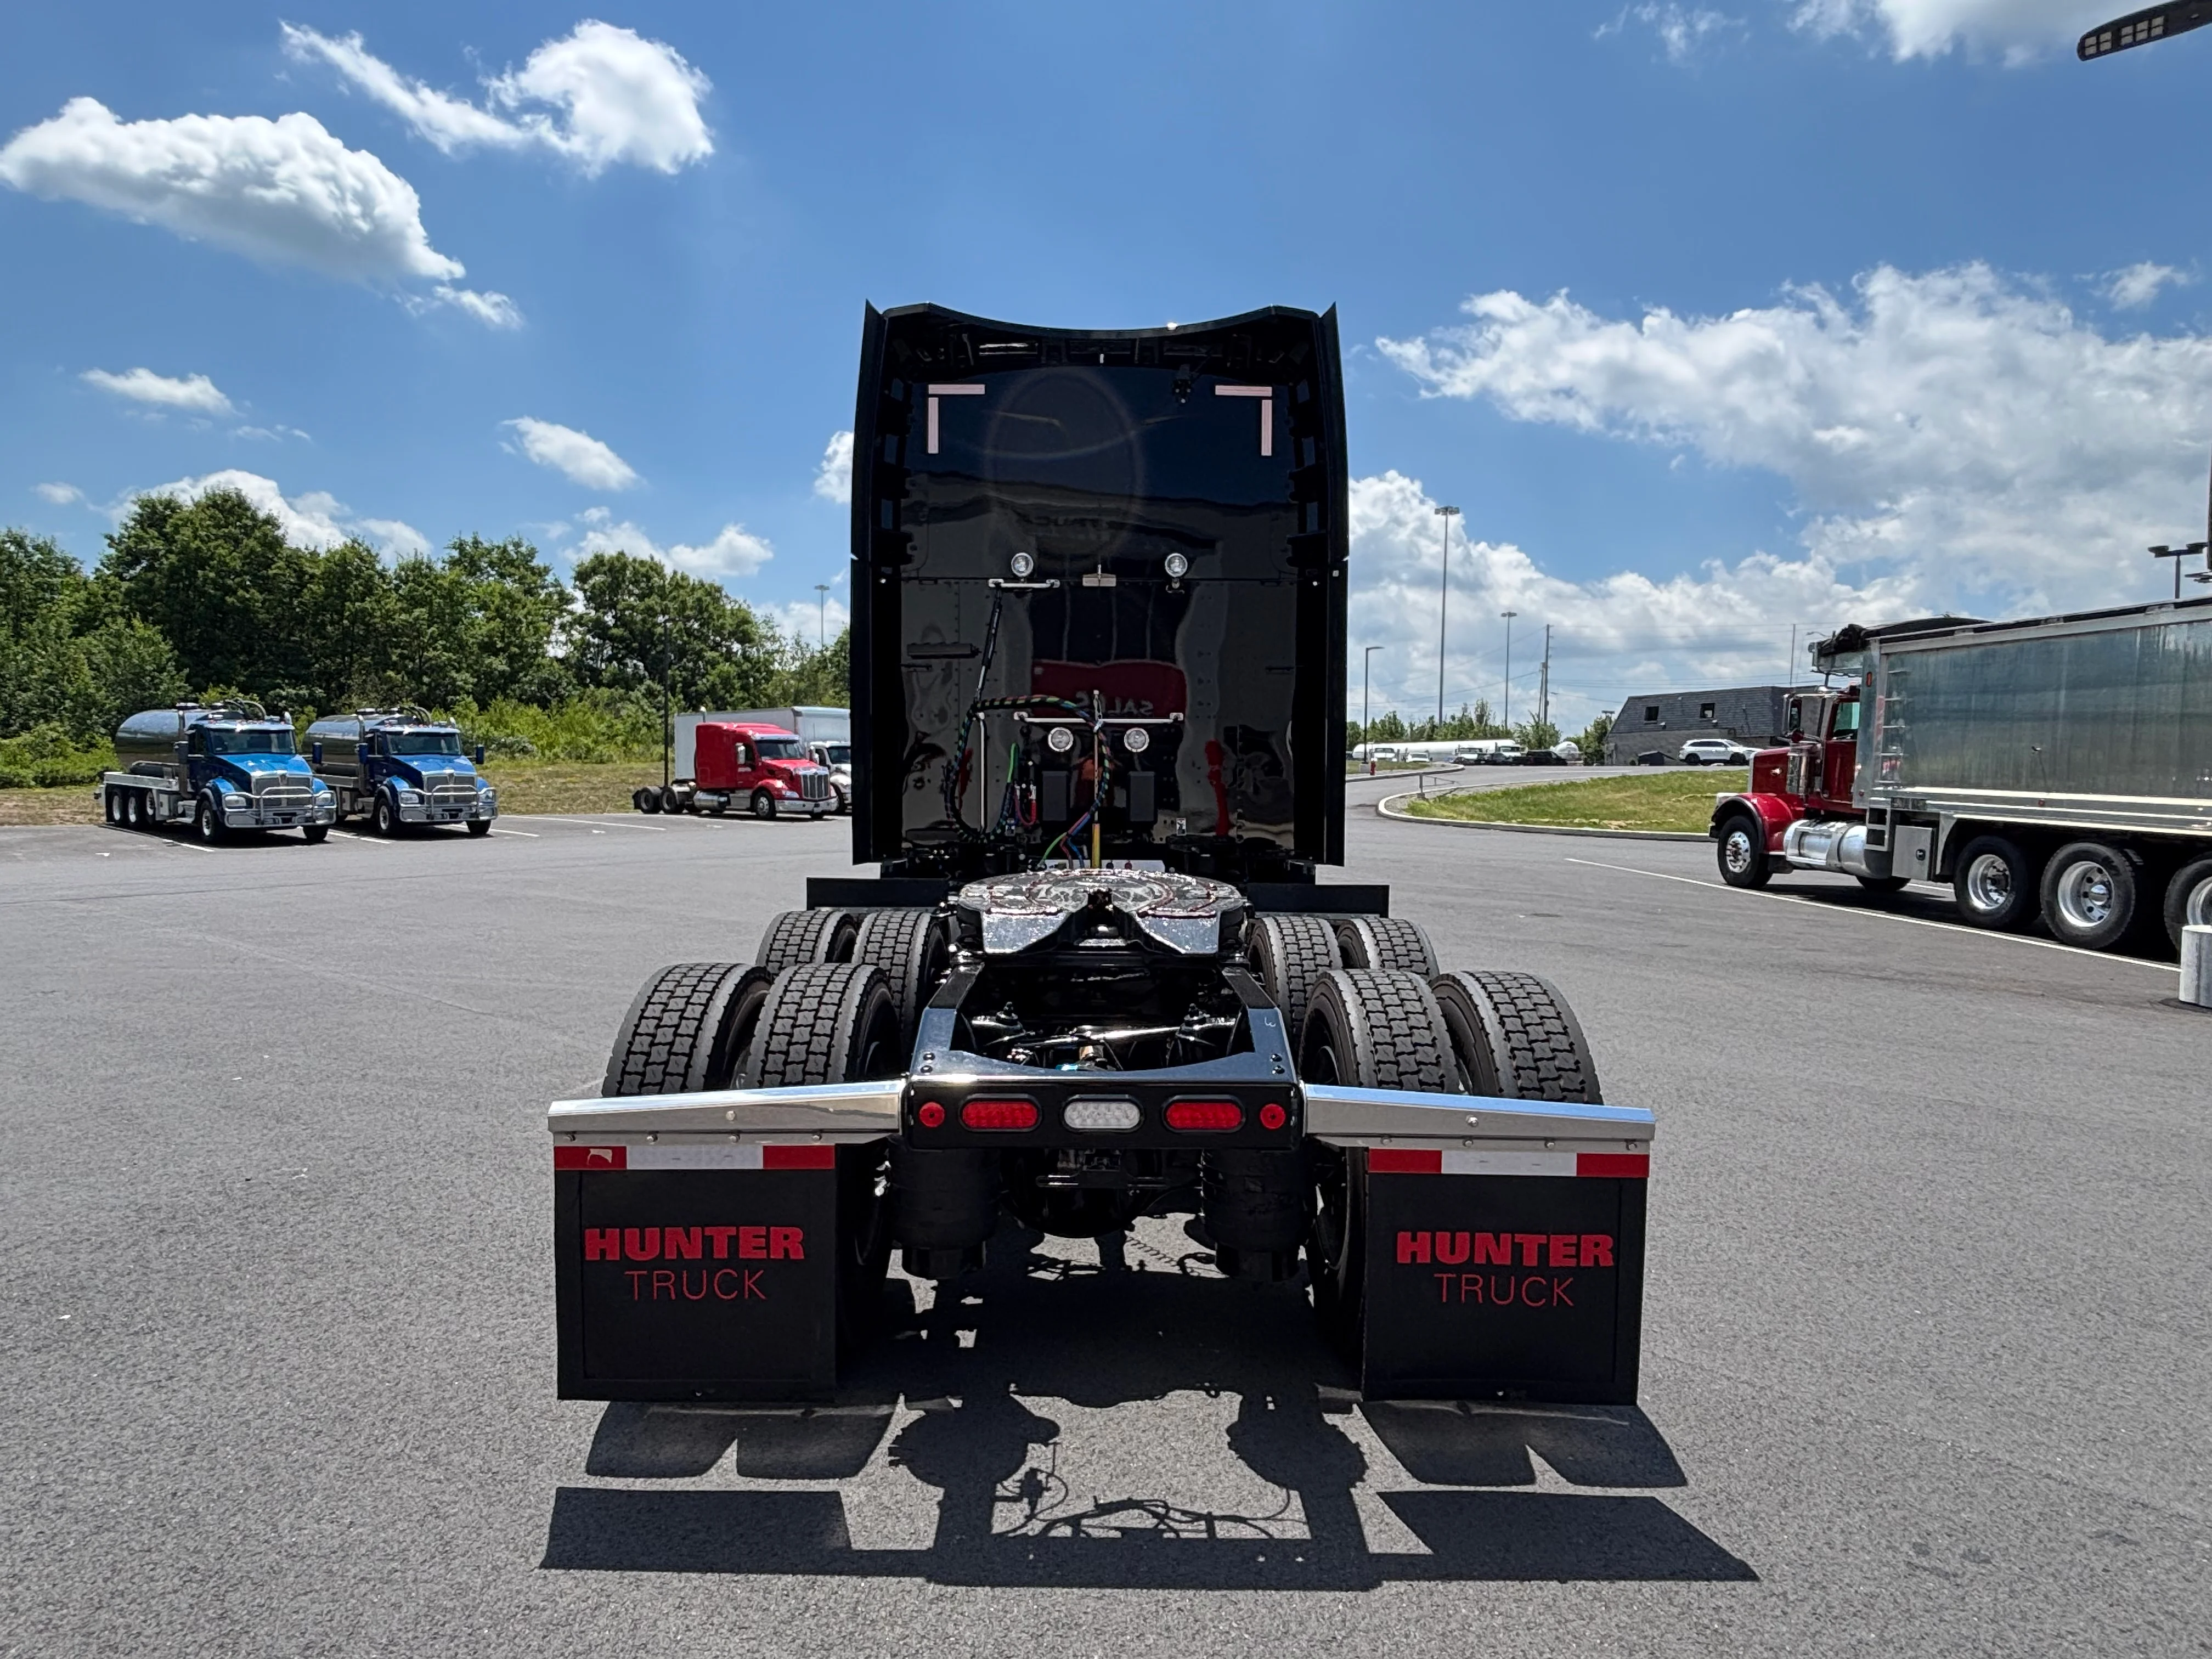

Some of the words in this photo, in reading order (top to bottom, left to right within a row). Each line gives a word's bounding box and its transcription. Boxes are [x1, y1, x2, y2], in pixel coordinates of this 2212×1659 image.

[584, 1226, 805, 1261] HUNTER
[1396, 1231, 1615, 1267] HUNTER
[624, 1268, 768, 1300] TRUCK
[1434, 1273, 1574, 1307] TRUCK
